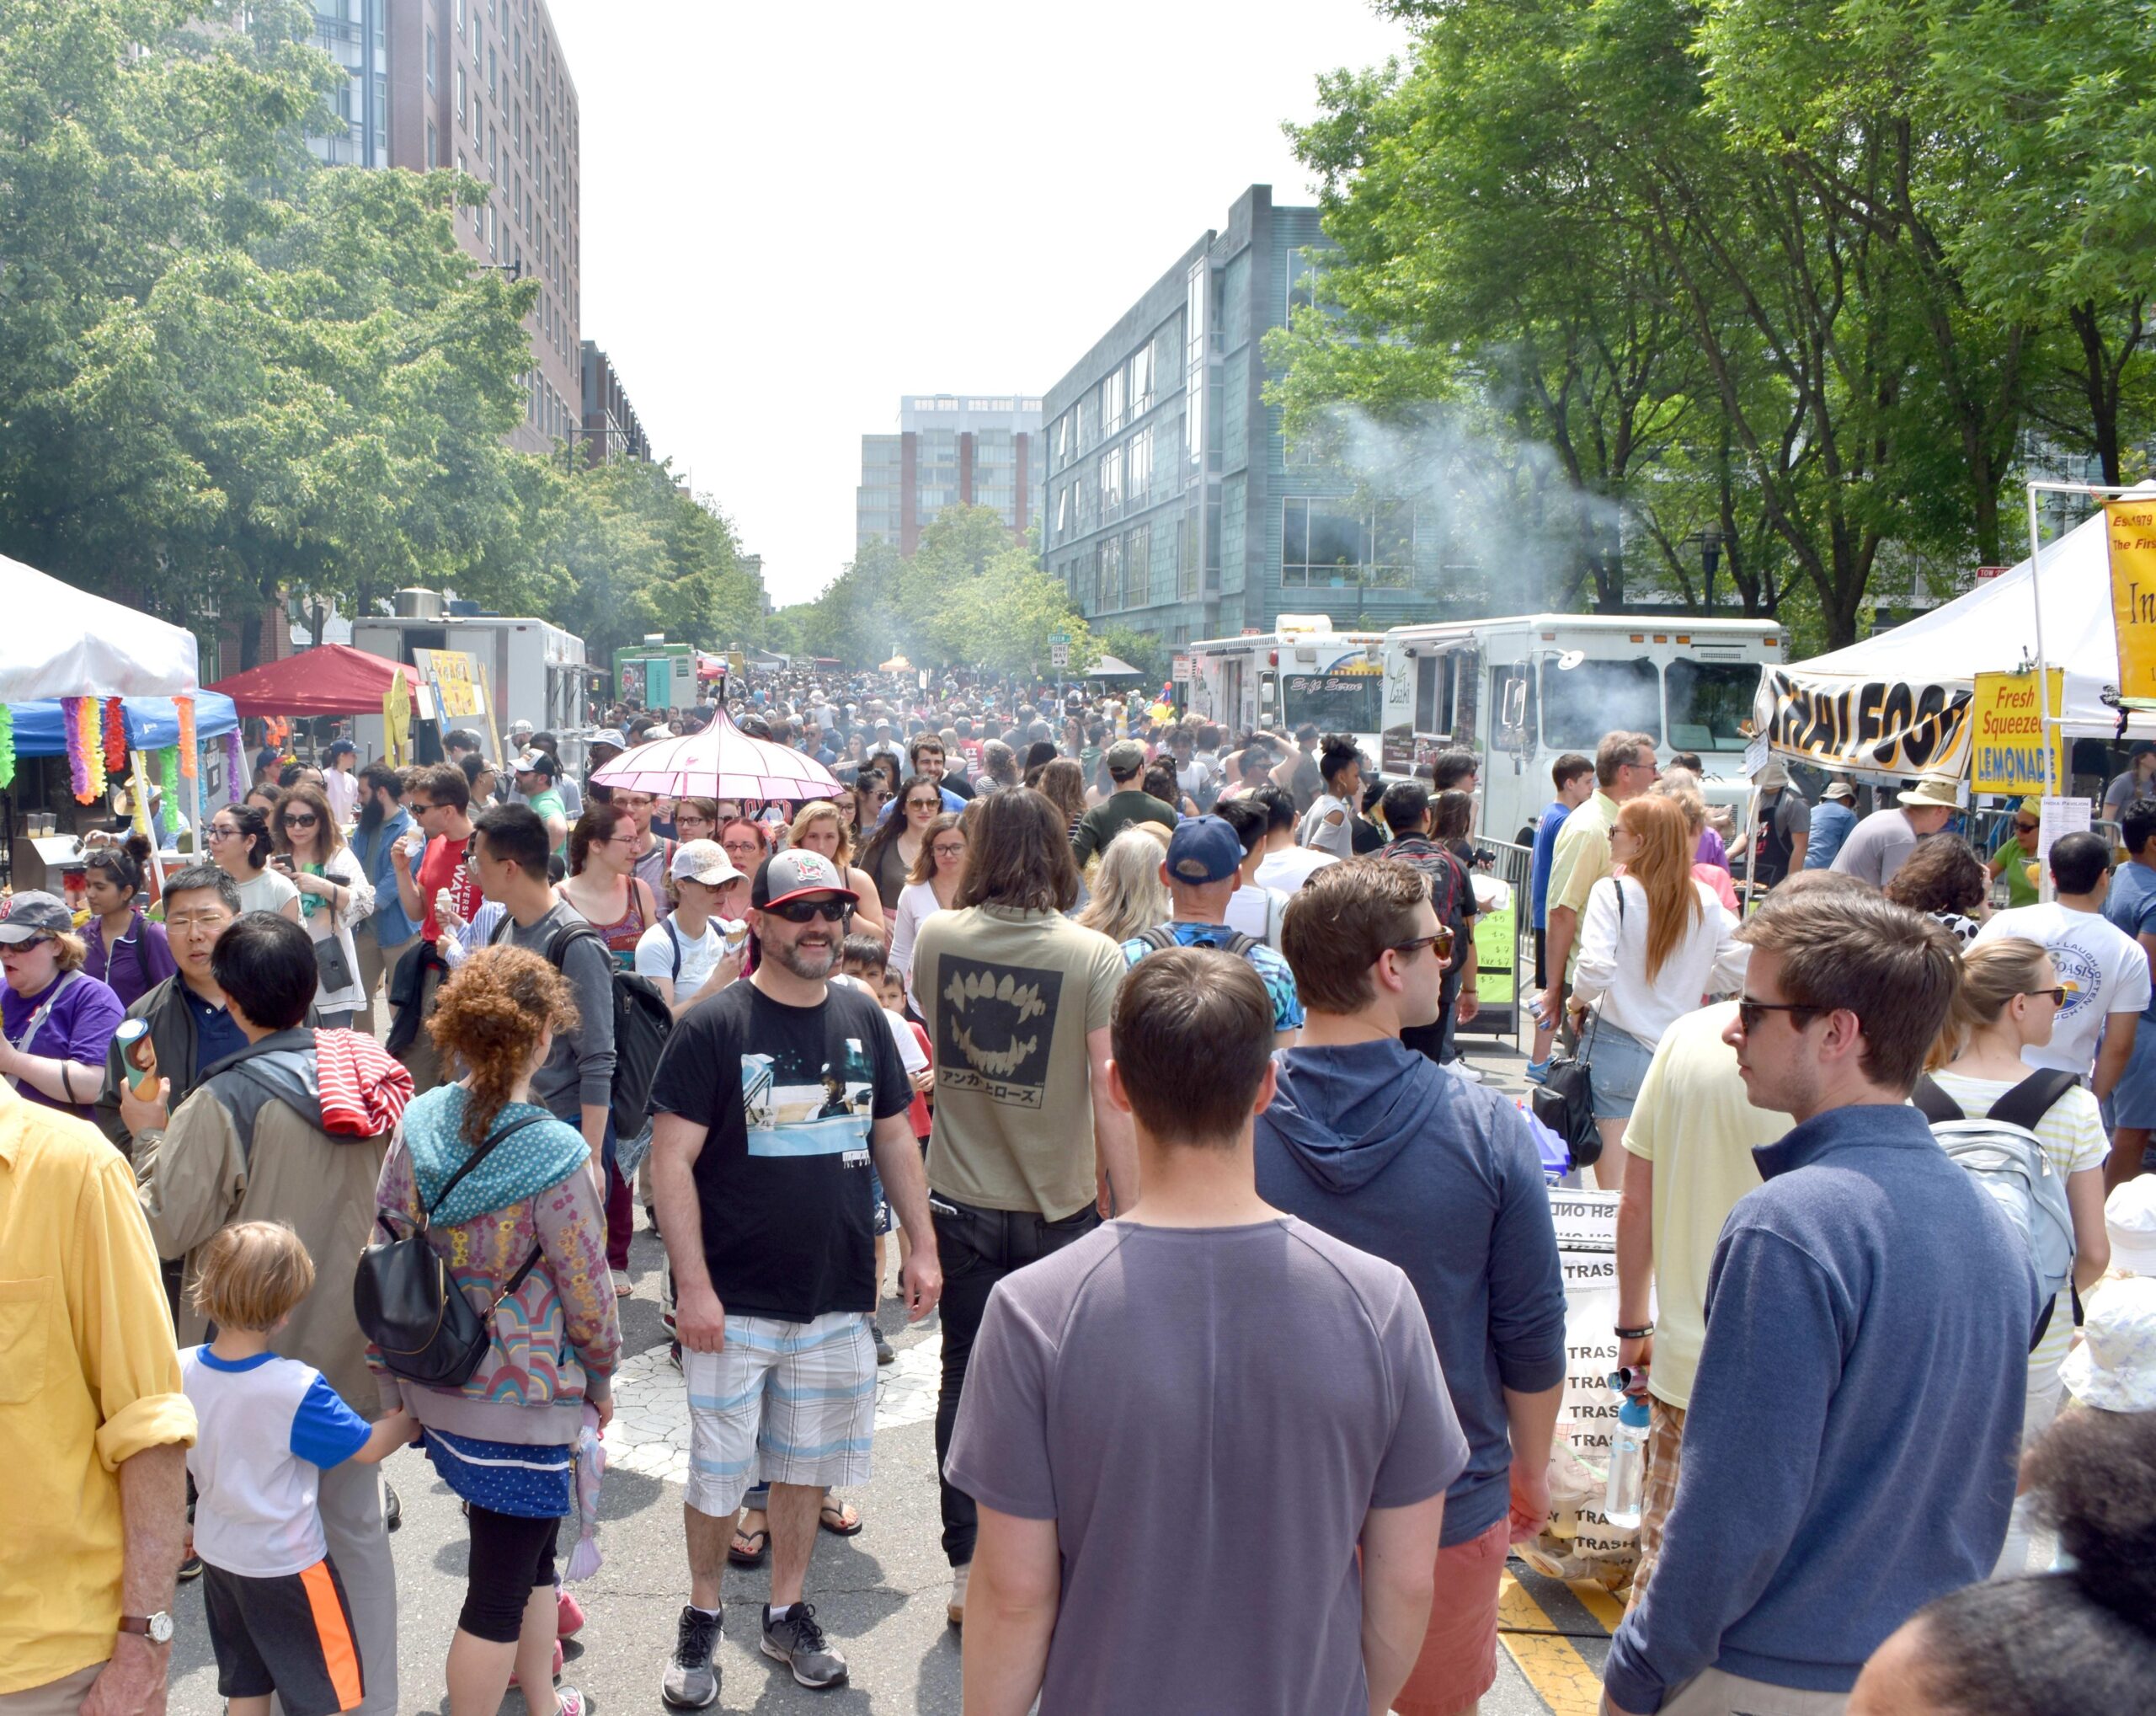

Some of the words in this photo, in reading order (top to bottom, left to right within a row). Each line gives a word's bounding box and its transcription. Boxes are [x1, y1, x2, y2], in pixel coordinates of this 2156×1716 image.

[2113, 539, 2131, 551] The
[1290, 677, 1321, 694] Soft
[1325, 678, 1364, 691] Serve
[1996, 685, 2035, 708] Fresh
[1769, 671, 1855, 762] THAI
[1849, 682, 1975, 770] FOOD
[450, 864, 466, 913] WATE
[2056, 961, 2094, 978] OASIS
[2063, 942, 2099, 967] LAUGH
[2083, 970, 2102, 1006] OFTEN
[2053, 1008, 2079, 1020] UCH
[1564, 1263, 1614, 1278] TRAS
[1567, 1345, 1619, 1359] TRAS
[1568, 1376, 1607, 1389] TRA
[1569, 1405, 1620, 1418] TRAS
[1571, 1435, 1613, 1446] TRA
[1574, 1509, 1610, 1525] TRA
[1574, 1536, 1636, 1550] TRASH
